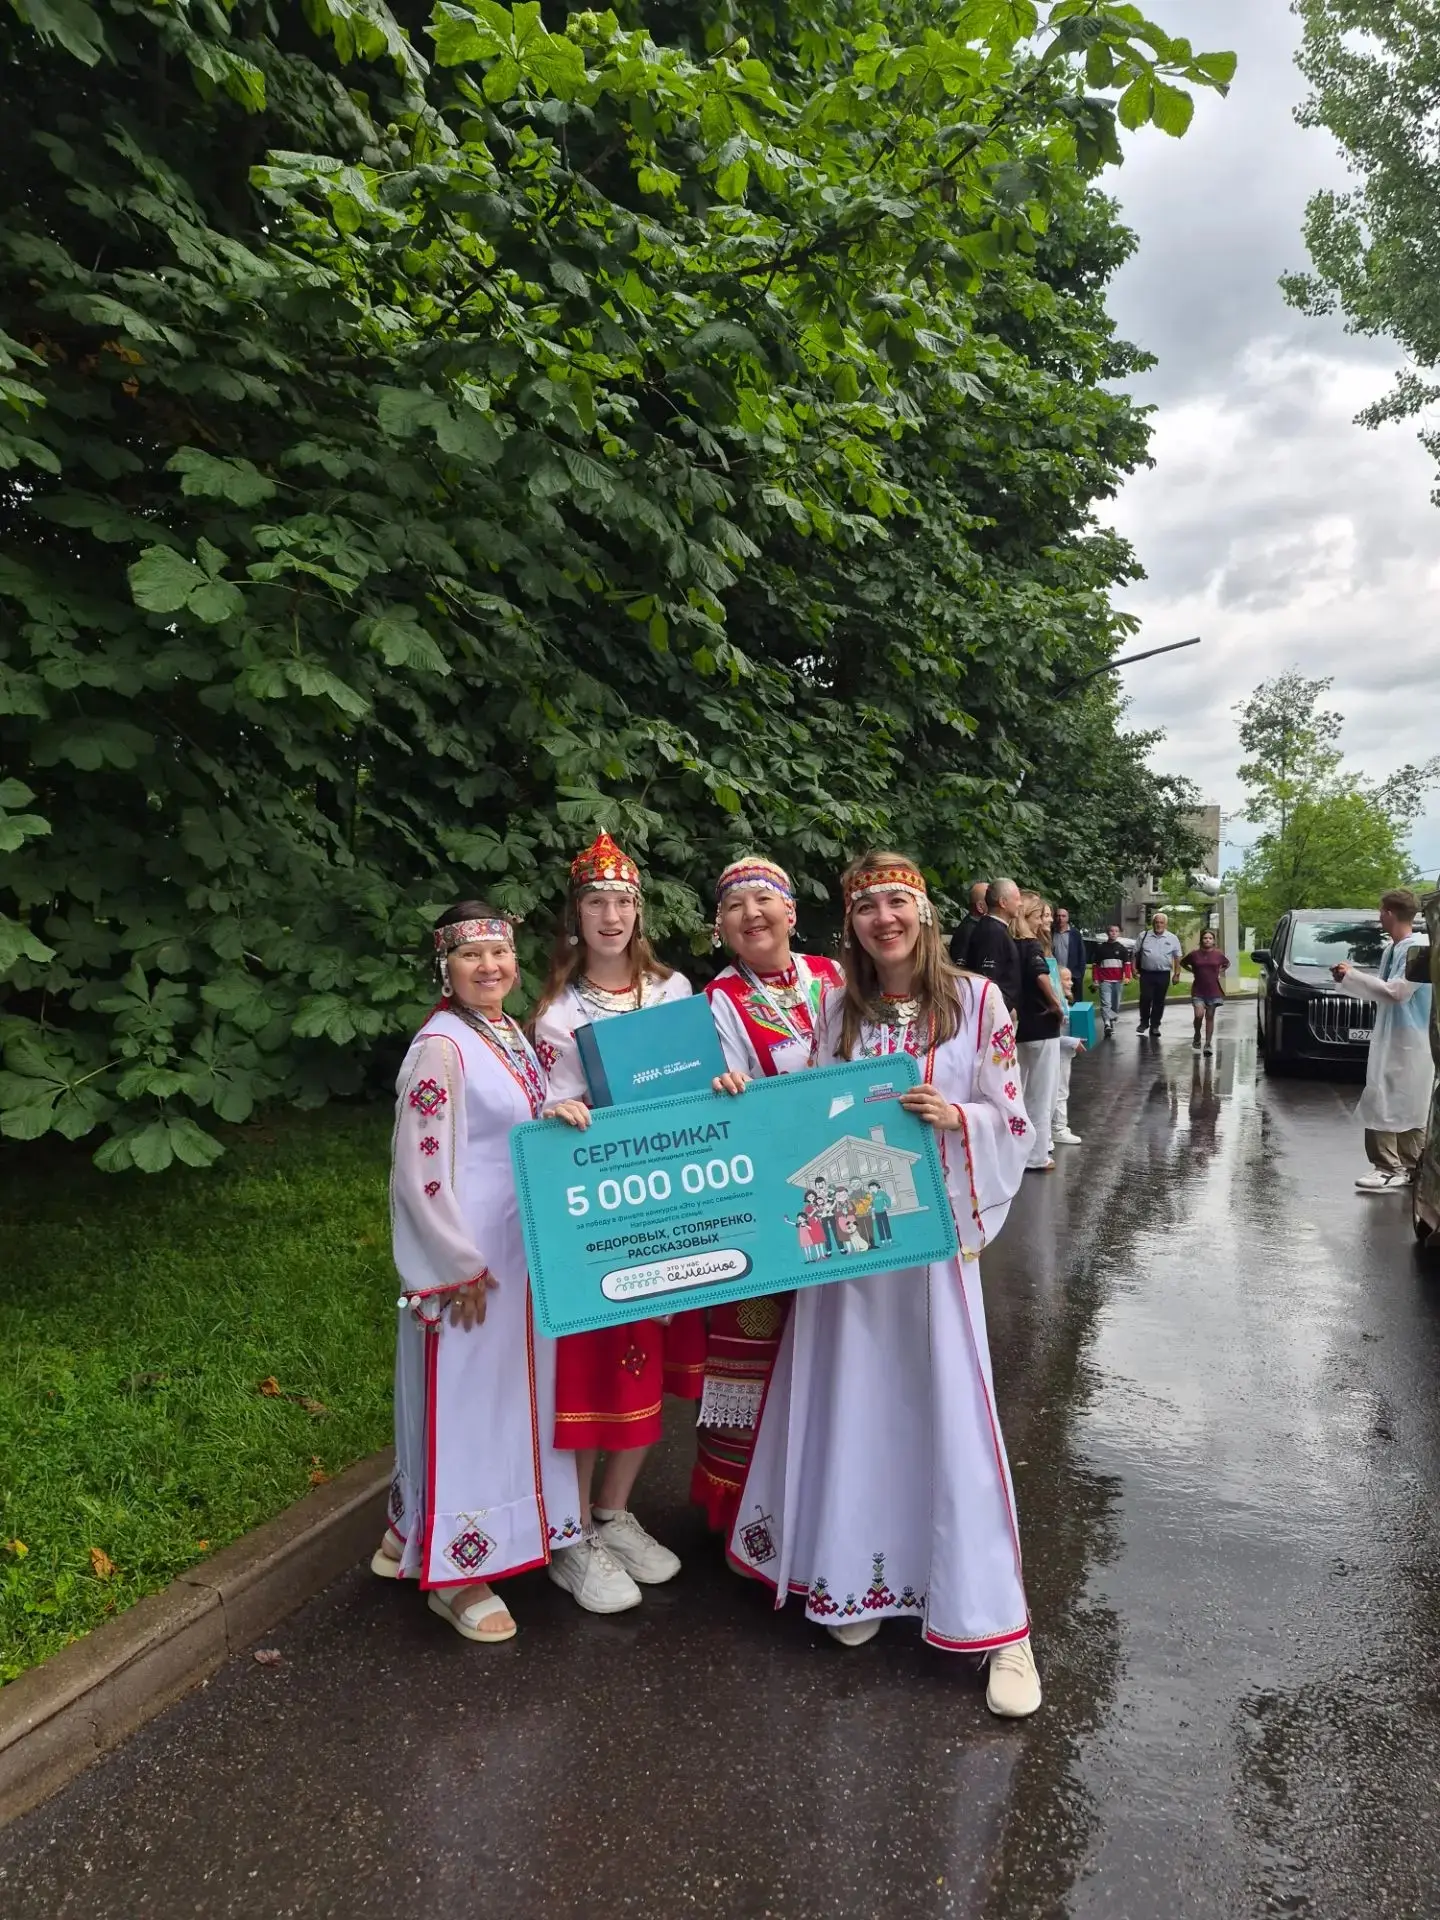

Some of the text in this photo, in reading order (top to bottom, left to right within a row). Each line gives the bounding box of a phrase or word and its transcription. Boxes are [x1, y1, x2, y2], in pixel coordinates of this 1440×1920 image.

[573, 1120, 731, 1167] СЕРТИФИКАТ
[685, 1145, 713, 1158] условий
[566, 1154, 754, 1216] 5 000 000
[586, 1212, 757, 1253] ФЕДОРОВЫХ, СТОЛЯРЕНКО,
[627, 1232, 720, 1259] РАССКАЗОВЫХ
[667, 1260, 738, 1282] семейное
[686, 1260, 700, 1268] нас
